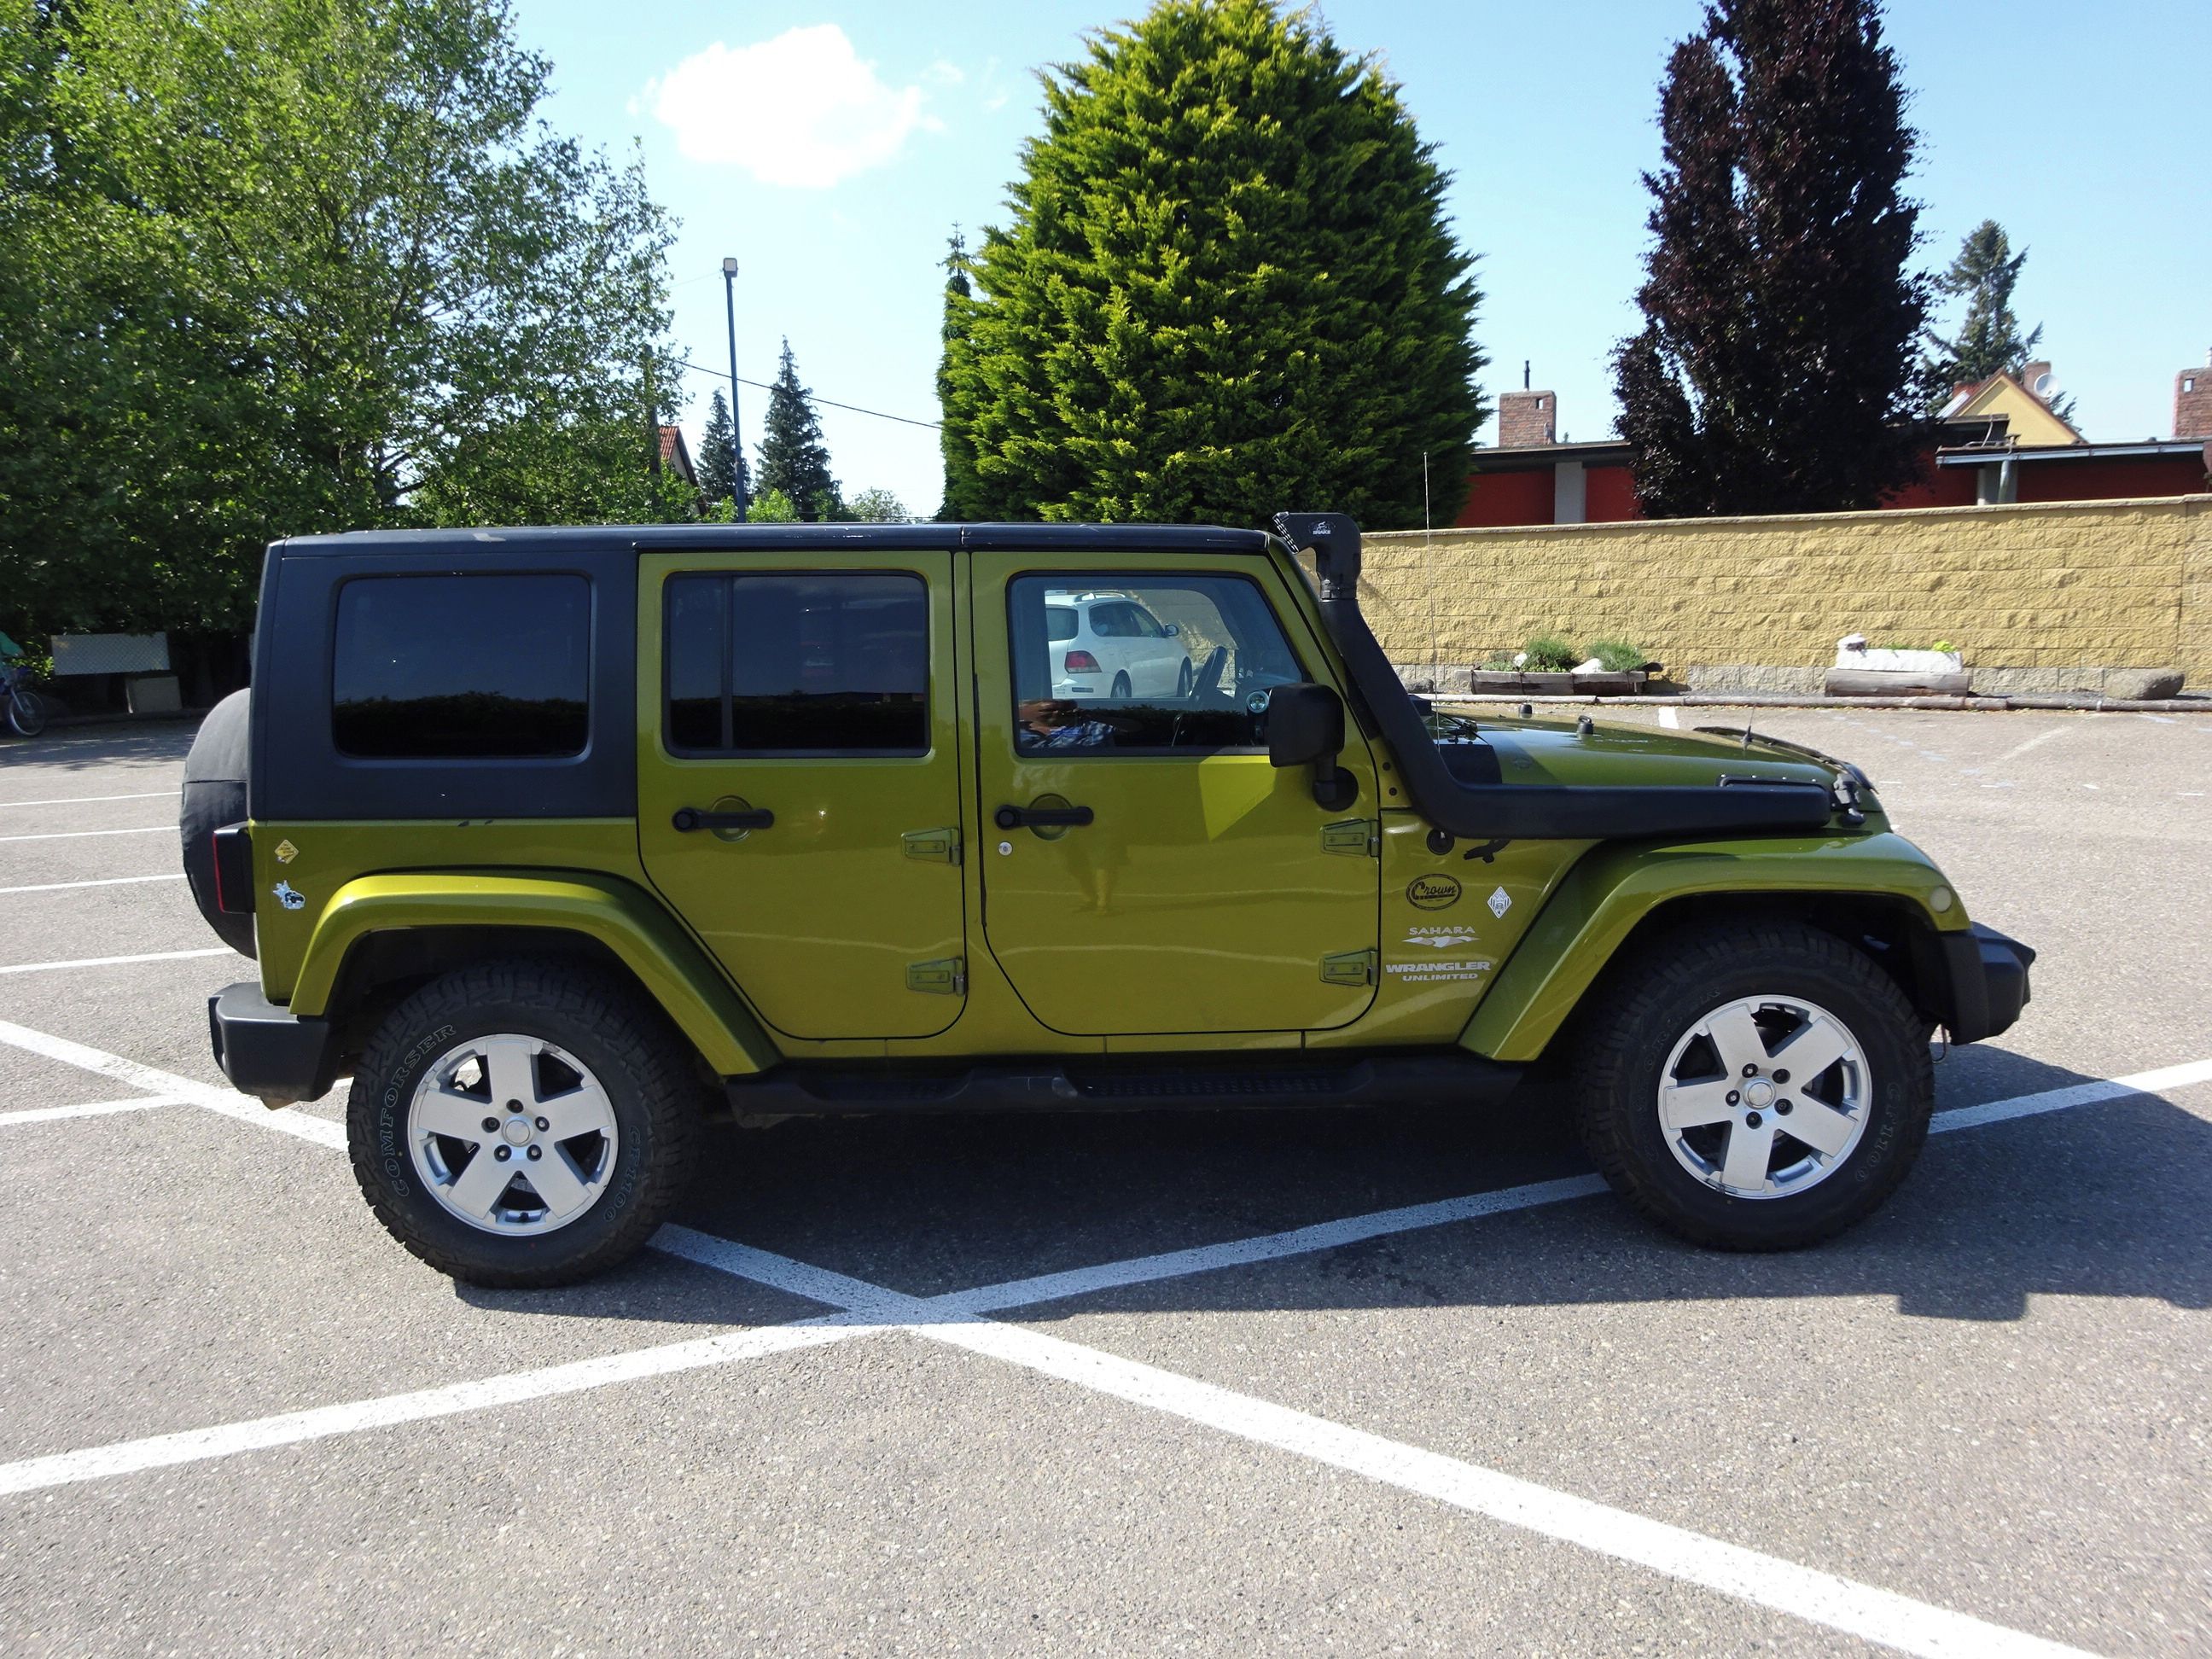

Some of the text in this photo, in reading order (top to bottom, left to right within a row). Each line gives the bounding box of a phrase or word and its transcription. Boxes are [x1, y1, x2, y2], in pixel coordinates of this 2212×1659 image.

[1411, 881, 1457, 899] Crown
[1409, 926, 1476, 935] SAHARA
[1385, 961, 1492, 973] WRANGLER
[1402, 973, 1479, 981] UNLIMITED
[380, 1023, 457, 1197] COMFORSER
